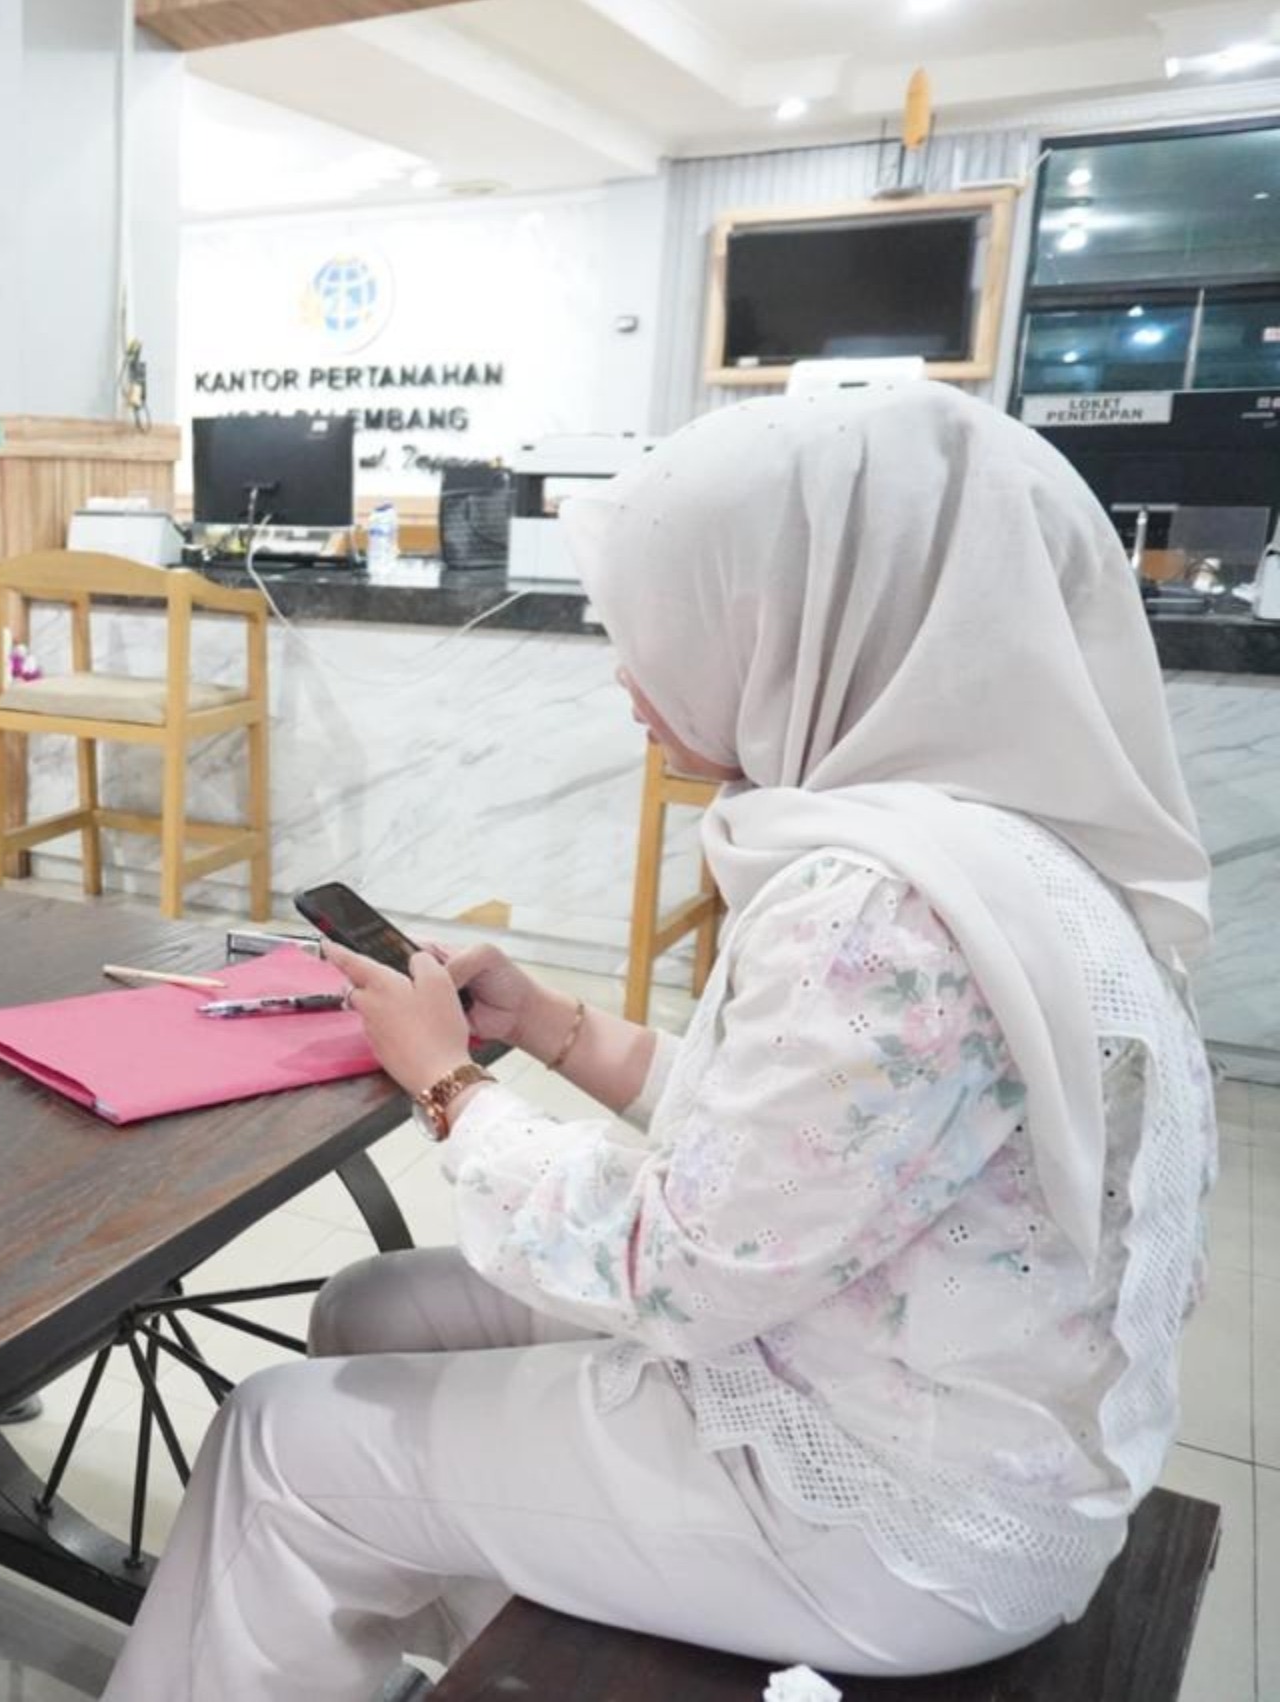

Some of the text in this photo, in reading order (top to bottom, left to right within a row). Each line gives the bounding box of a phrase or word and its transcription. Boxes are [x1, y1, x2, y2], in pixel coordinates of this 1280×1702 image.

[195, 363, 504, 392] KANTOR PERTANAHAN
[1070, 397, 1122, 410] LOKET
[1046, 409, 1144, 422] PENETAPAN
